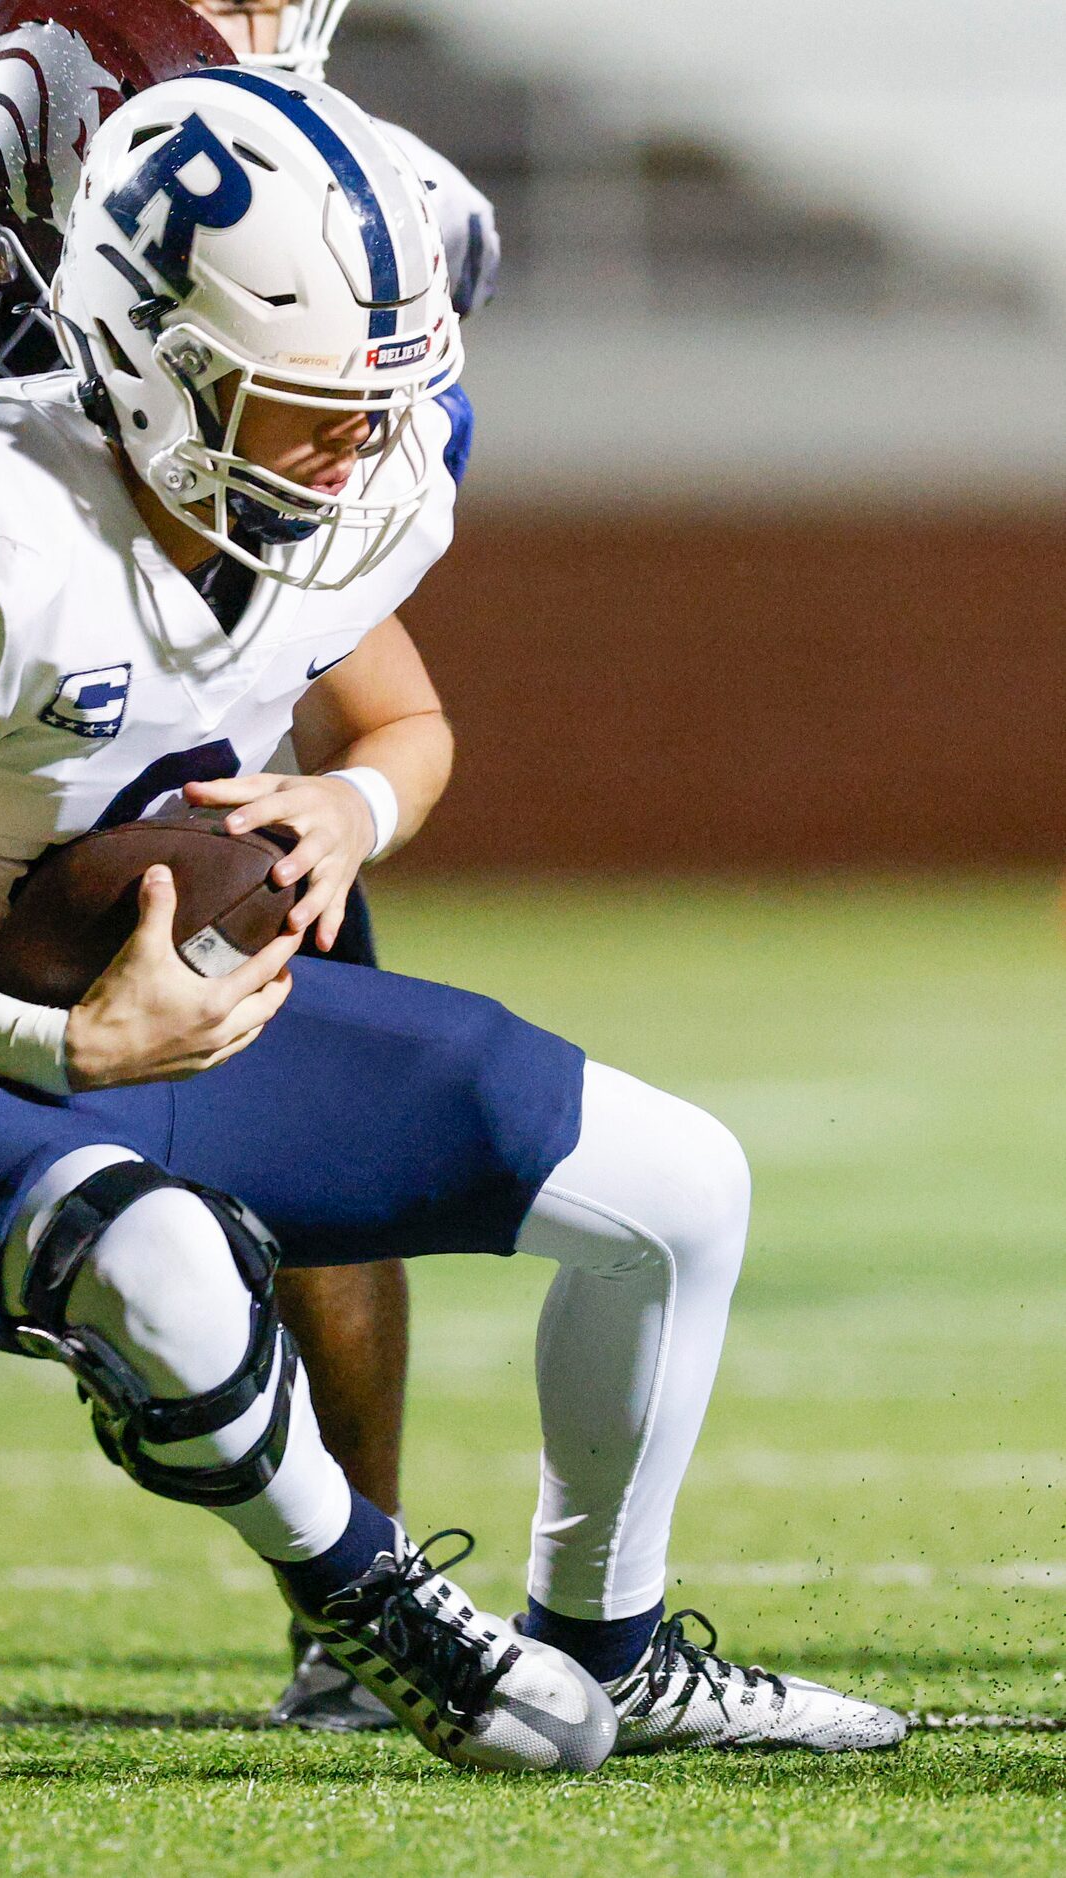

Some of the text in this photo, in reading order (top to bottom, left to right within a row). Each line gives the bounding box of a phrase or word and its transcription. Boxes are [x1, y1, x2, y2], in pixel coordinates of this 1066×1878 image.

[103, 112, 252, 299] R
[288, 356, 330, 366] MORTON
[377, 342, 427, 365] BELIEVE
[51, 665, 130, 724] C
